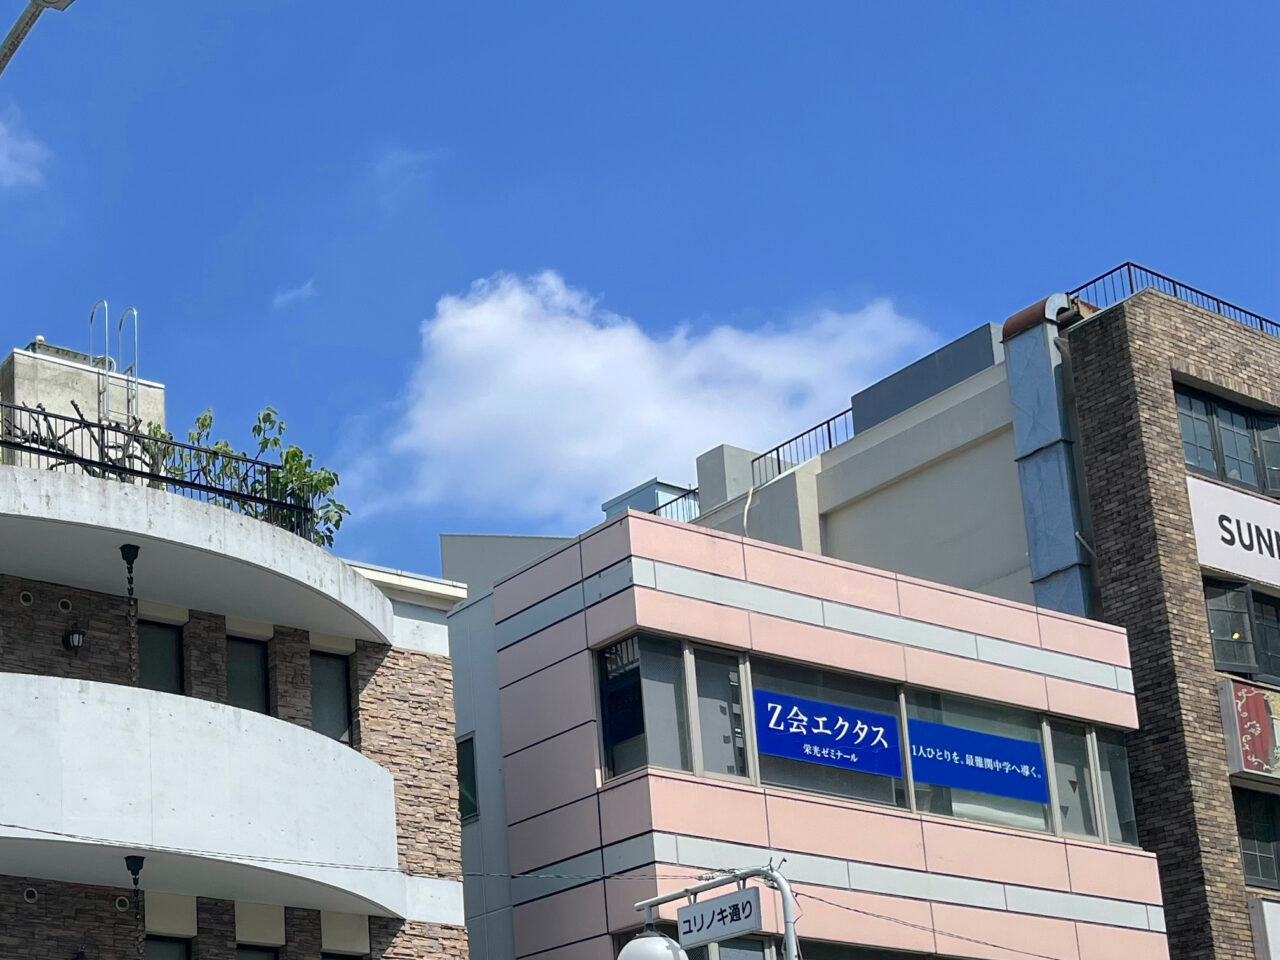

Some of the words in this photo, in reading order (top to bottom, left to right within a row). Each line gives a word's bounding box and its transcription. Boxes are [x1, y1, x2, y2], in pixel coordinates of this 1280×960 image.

[1218, 514, 1280, 560] SUN
[767, 702, 889, 748] Z会エクタス
[803, 744, 858, 763] 栄光ゼミナール
[682, 900, 753, 935] ユリノキ通り
